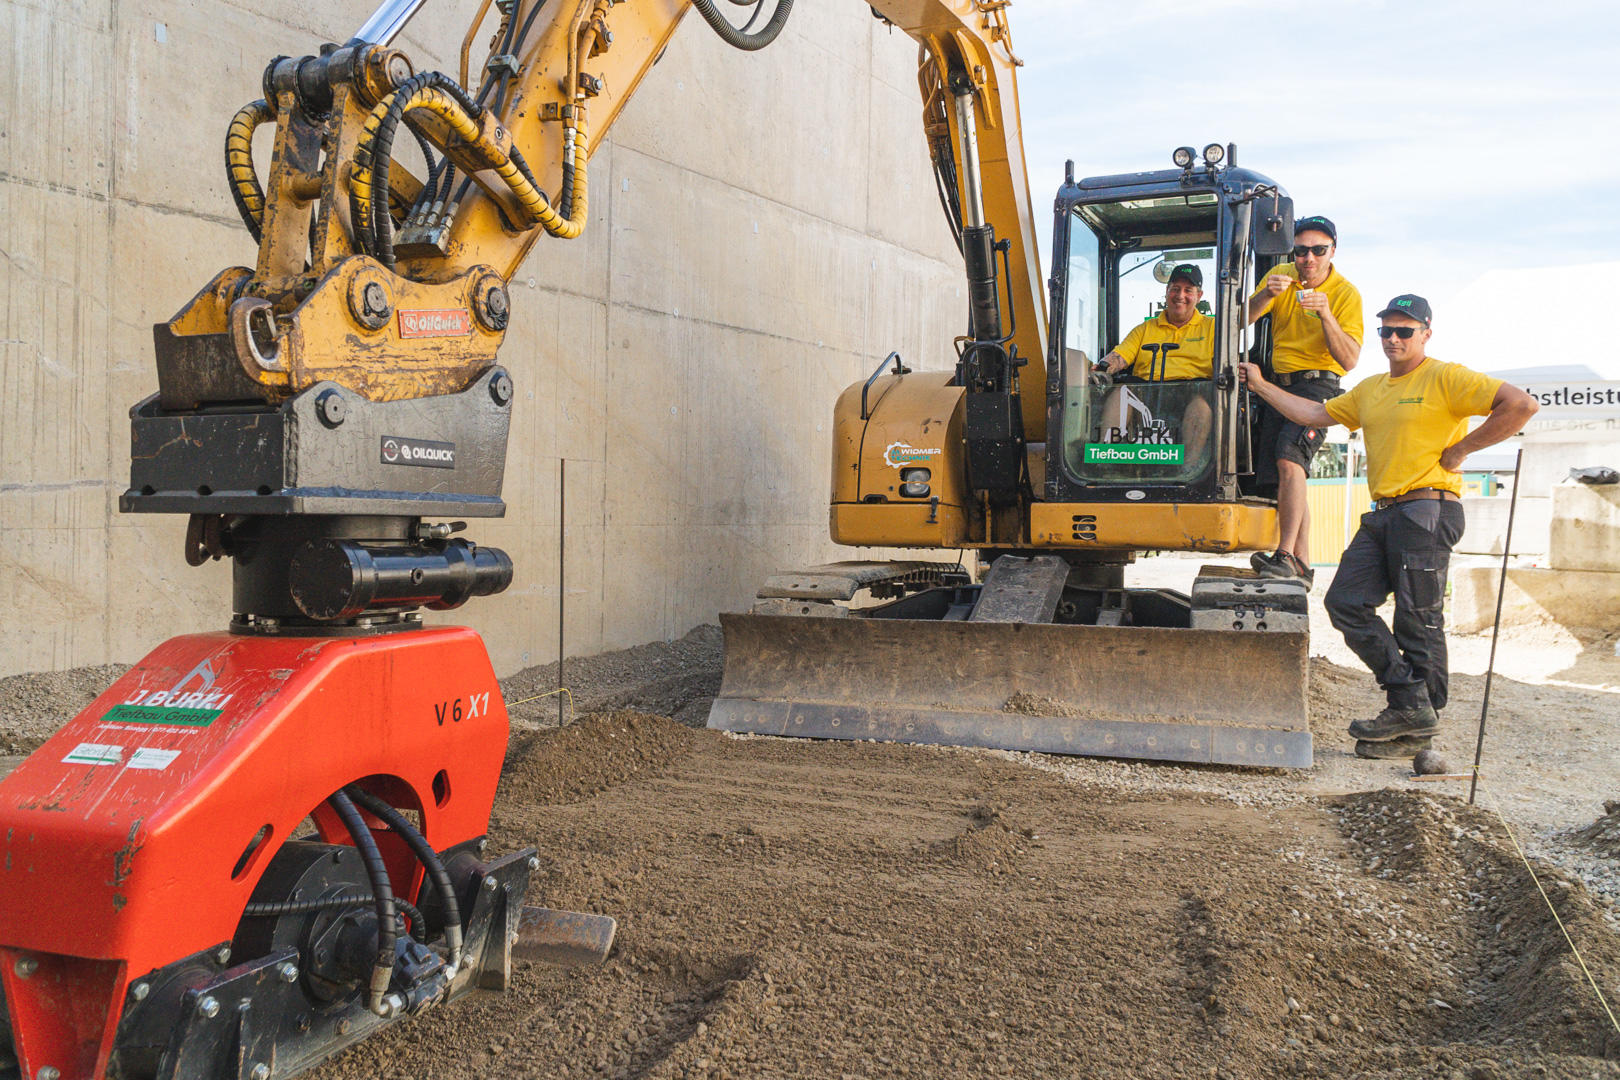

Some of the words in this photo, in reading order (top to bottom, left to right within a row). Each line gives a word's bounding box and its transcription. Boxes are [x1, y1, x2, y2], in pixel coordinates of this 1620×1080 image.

[412, 446, 454, 462] OILQUICK
[1089, 447, 1135, 461] Tiefbau
[1137, 448, 1179, 461] GmbH
[111, 707, 164, 721] Tiefbau
[164, 711, 214, 723] GmbH
[434, 701, 447, 727] V
[453, 698, 462, 723] 6
[466, 691, 490, 720] X1
